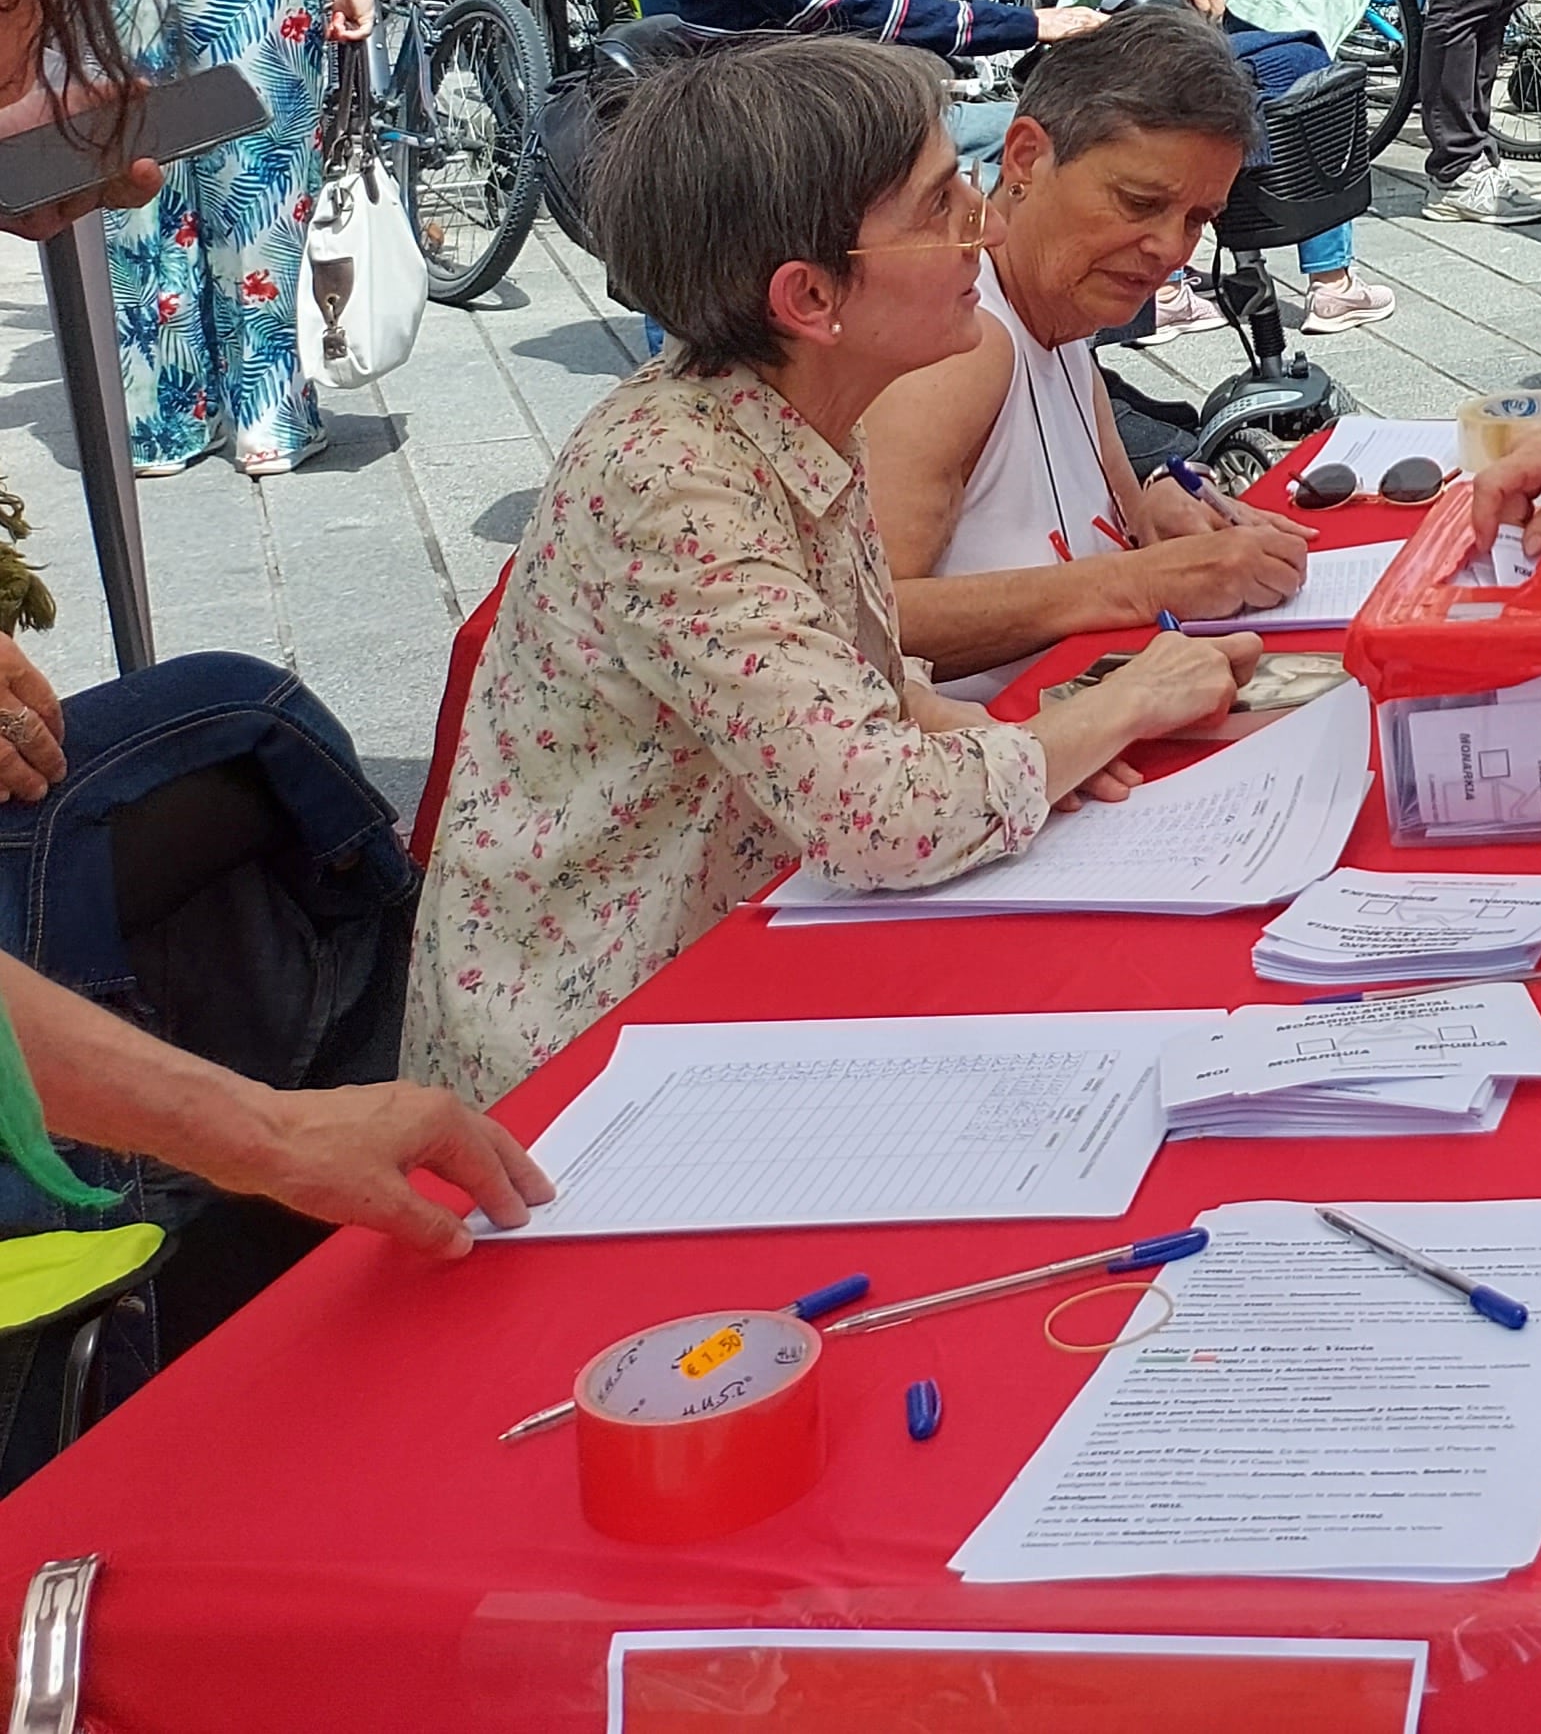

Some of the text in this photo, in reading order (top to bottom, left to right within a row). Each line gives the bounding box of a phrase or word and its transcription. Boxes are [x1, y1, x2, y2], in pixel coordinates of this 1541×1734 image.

[1459, 732, 1475, 801] MONARKIA
[1386, 999, 1452, 1012] ESTATAL
[1275, 1014, 1377, 1032] MONARQUÍA
[1393, 1002, 1486, 1017] REPÚBLICA
[1414, 1039, 1509, 1051] REPÚBLICA
[1266, 1048, 1371, 1068] MONARQUÍA
